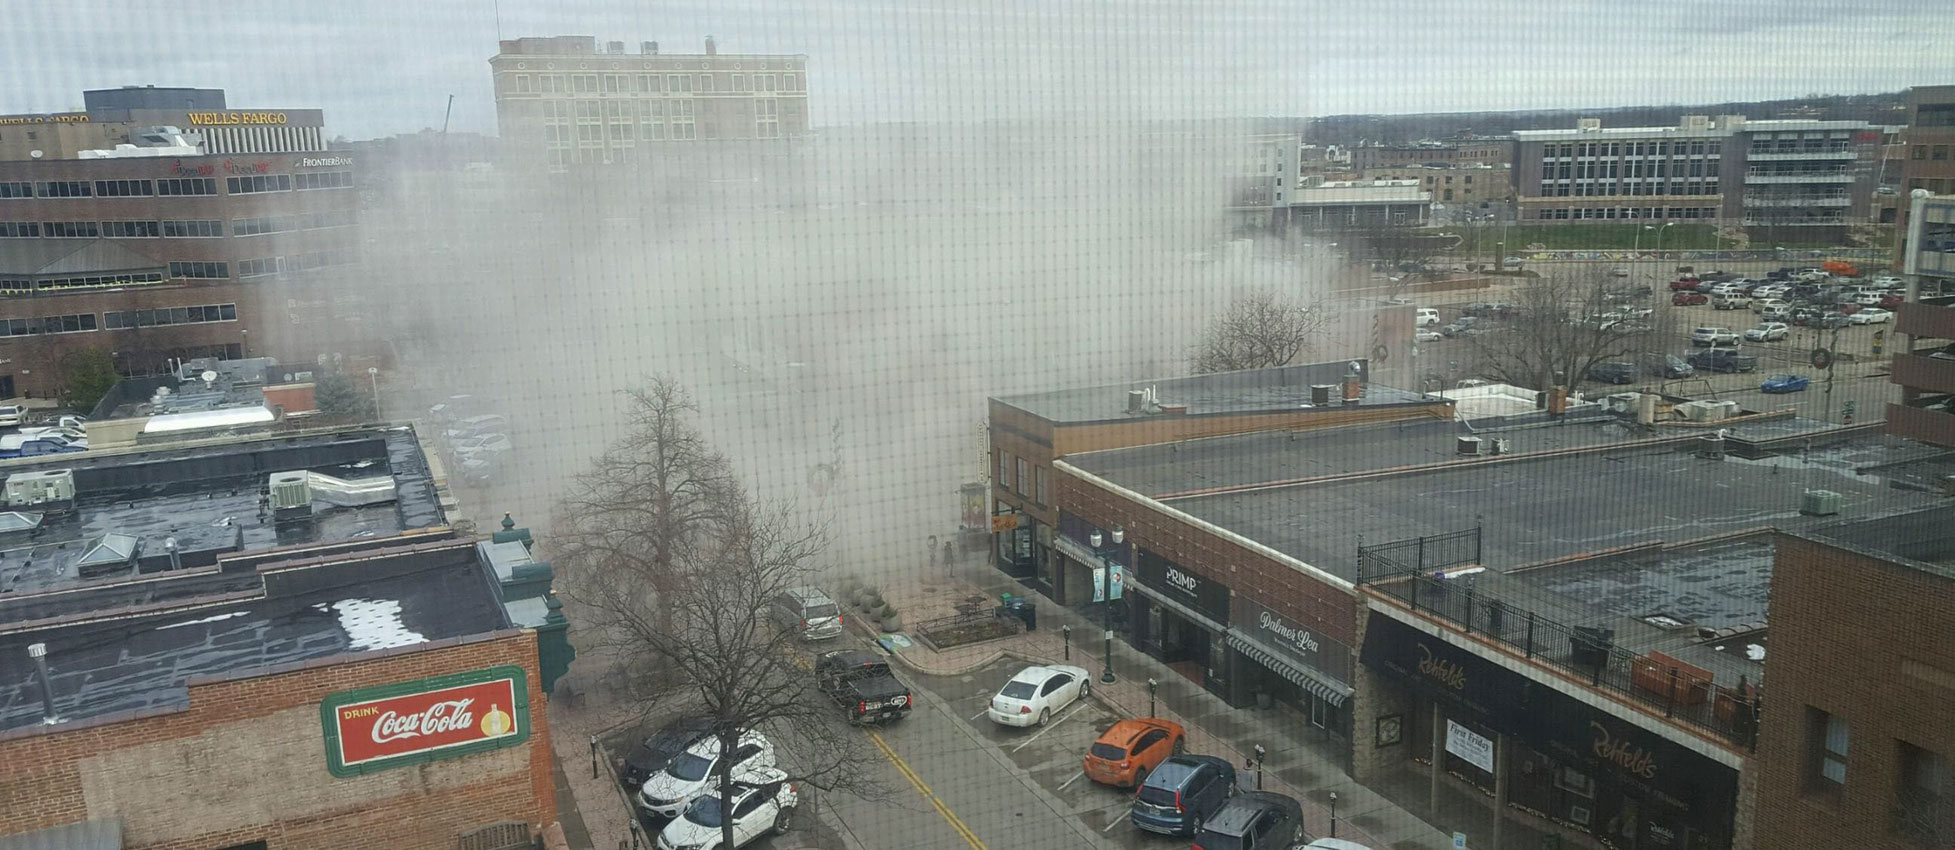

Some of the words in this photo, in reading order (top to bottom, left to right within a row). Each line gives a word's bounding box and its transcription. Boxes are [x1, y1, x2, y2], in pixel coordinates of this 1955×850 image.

[188, 112, 239, 125] WELLS
[242, 112, 287, 124] FARGO
[1166, 566, 1197, 591] PRIMP
[1259, 611, 1296, 641] Palmer
[1296, 629, 1319, 653] Lea
[343, 706, 379, 720] DRINK
[371, 698, 475, 744] Coca-Cola
[1450, 723, 1466, 739] First
[1468, 732, 1489, 752] Friday
